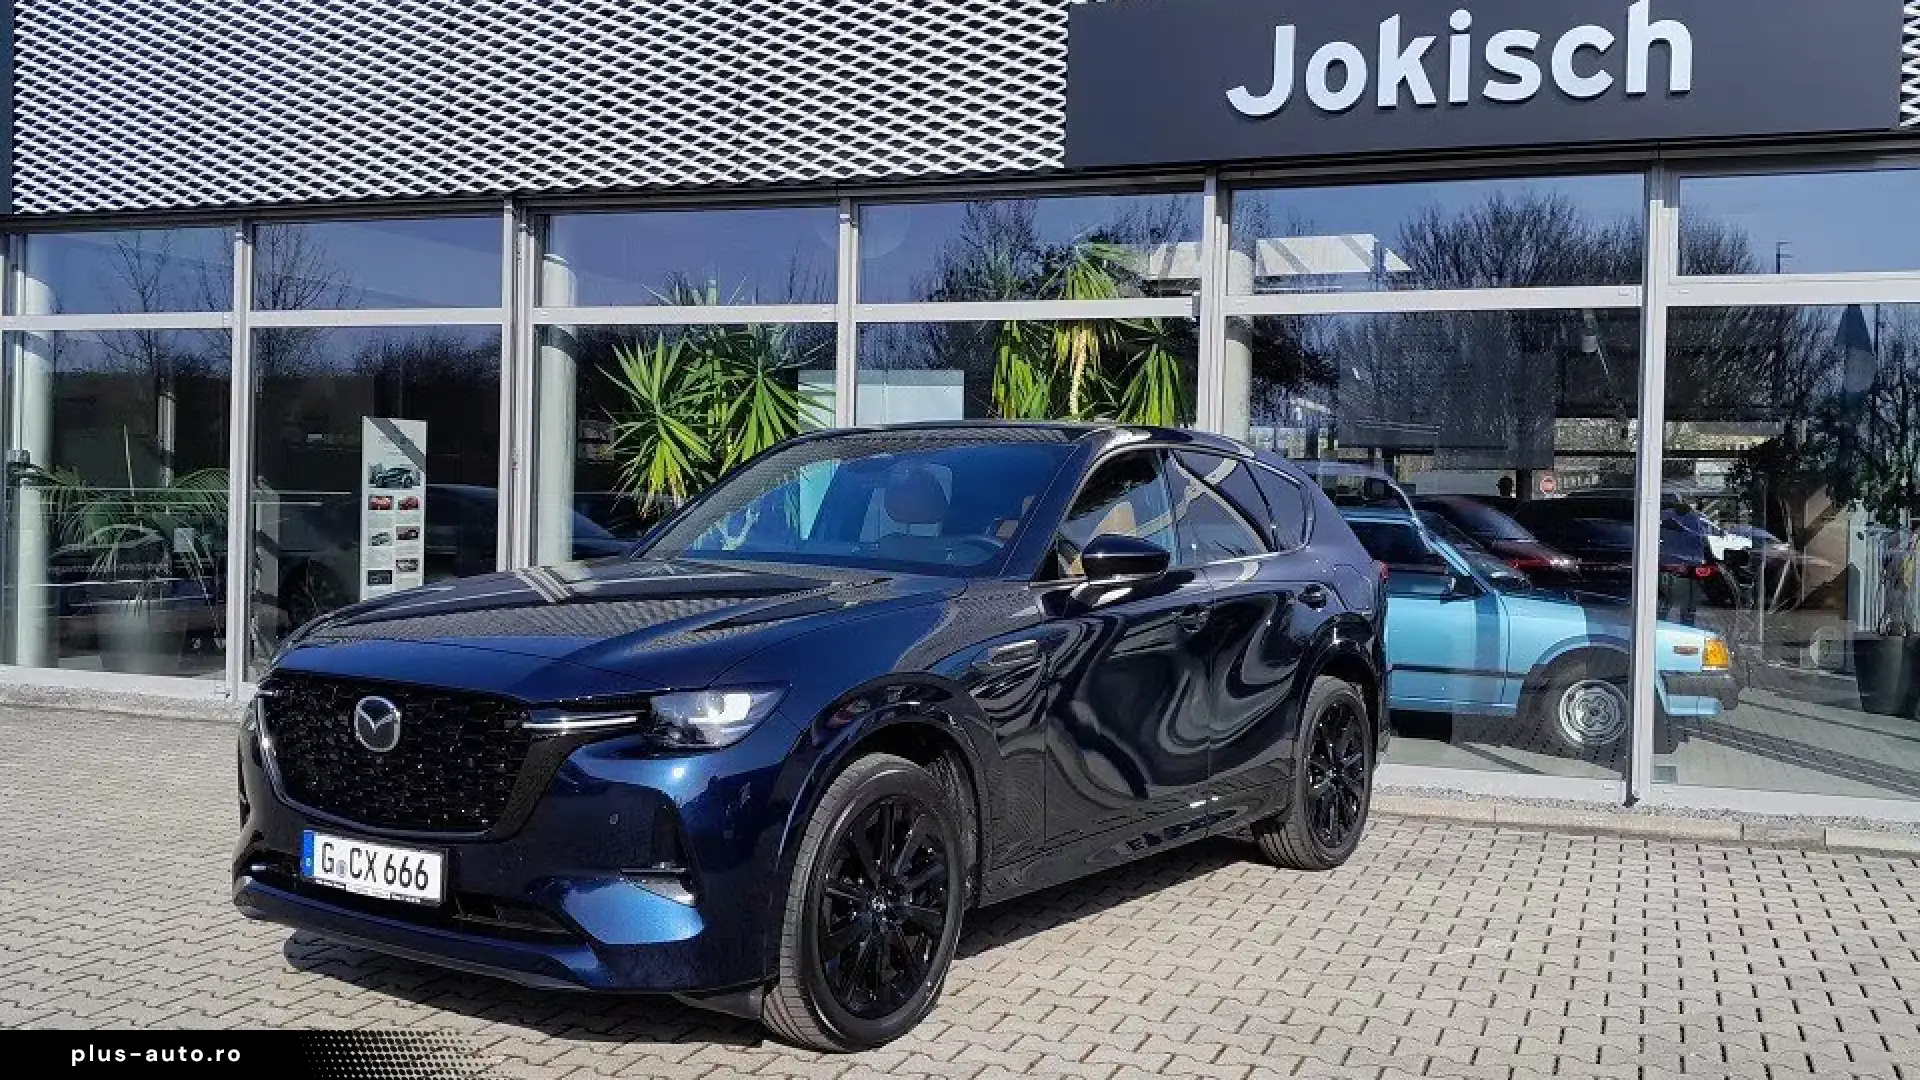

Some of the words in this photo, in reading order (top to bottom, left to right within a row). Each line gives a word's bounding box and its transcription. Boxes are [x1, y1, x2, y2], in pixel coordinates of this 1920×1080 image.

[1225, 0, 1693, 117] Jokisch
[321, 842, 335, 874] G
[350, 847, 378, 882] CX
[384, 853, 429, 891] 666
